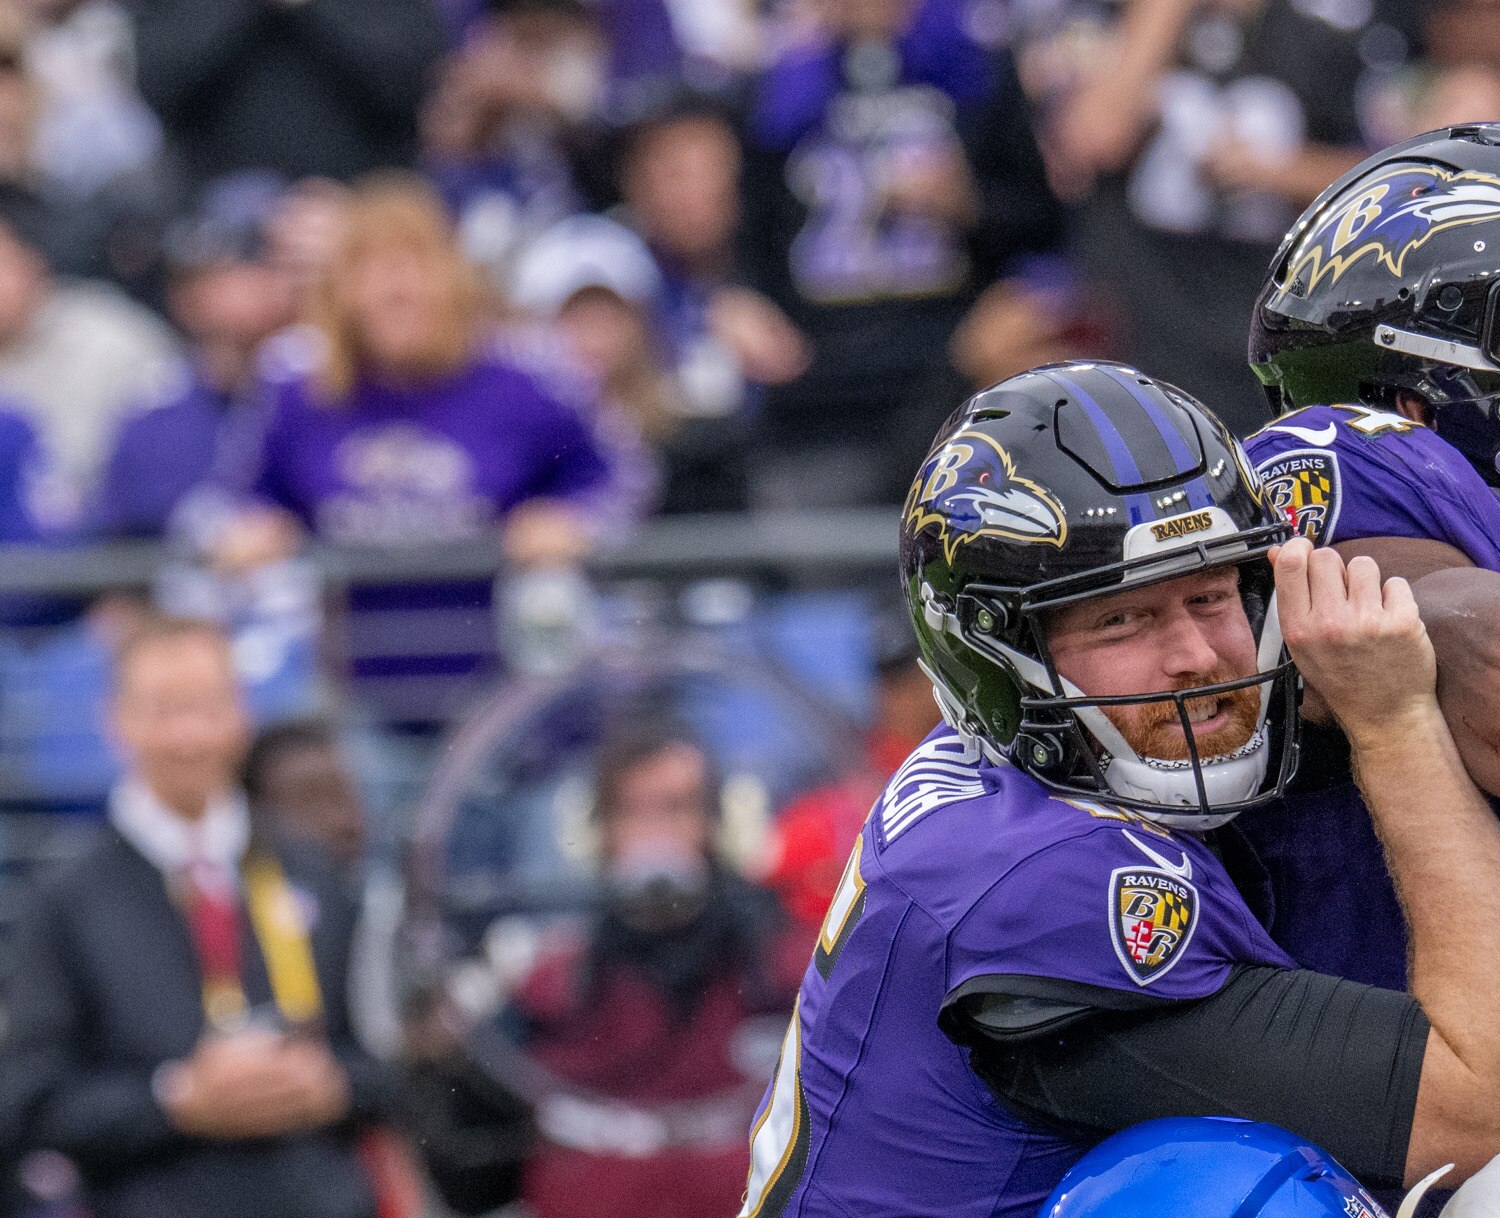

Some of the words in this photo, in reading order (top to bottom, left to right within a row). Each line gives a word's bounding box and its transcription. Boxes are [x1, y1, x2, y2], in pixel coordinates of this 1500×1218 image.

[1261, 459, 1325, 483] RAVENS
[1150, 511, 1214, 542] RAVENS
[1122, 875, 1188, 899] RAVENS
